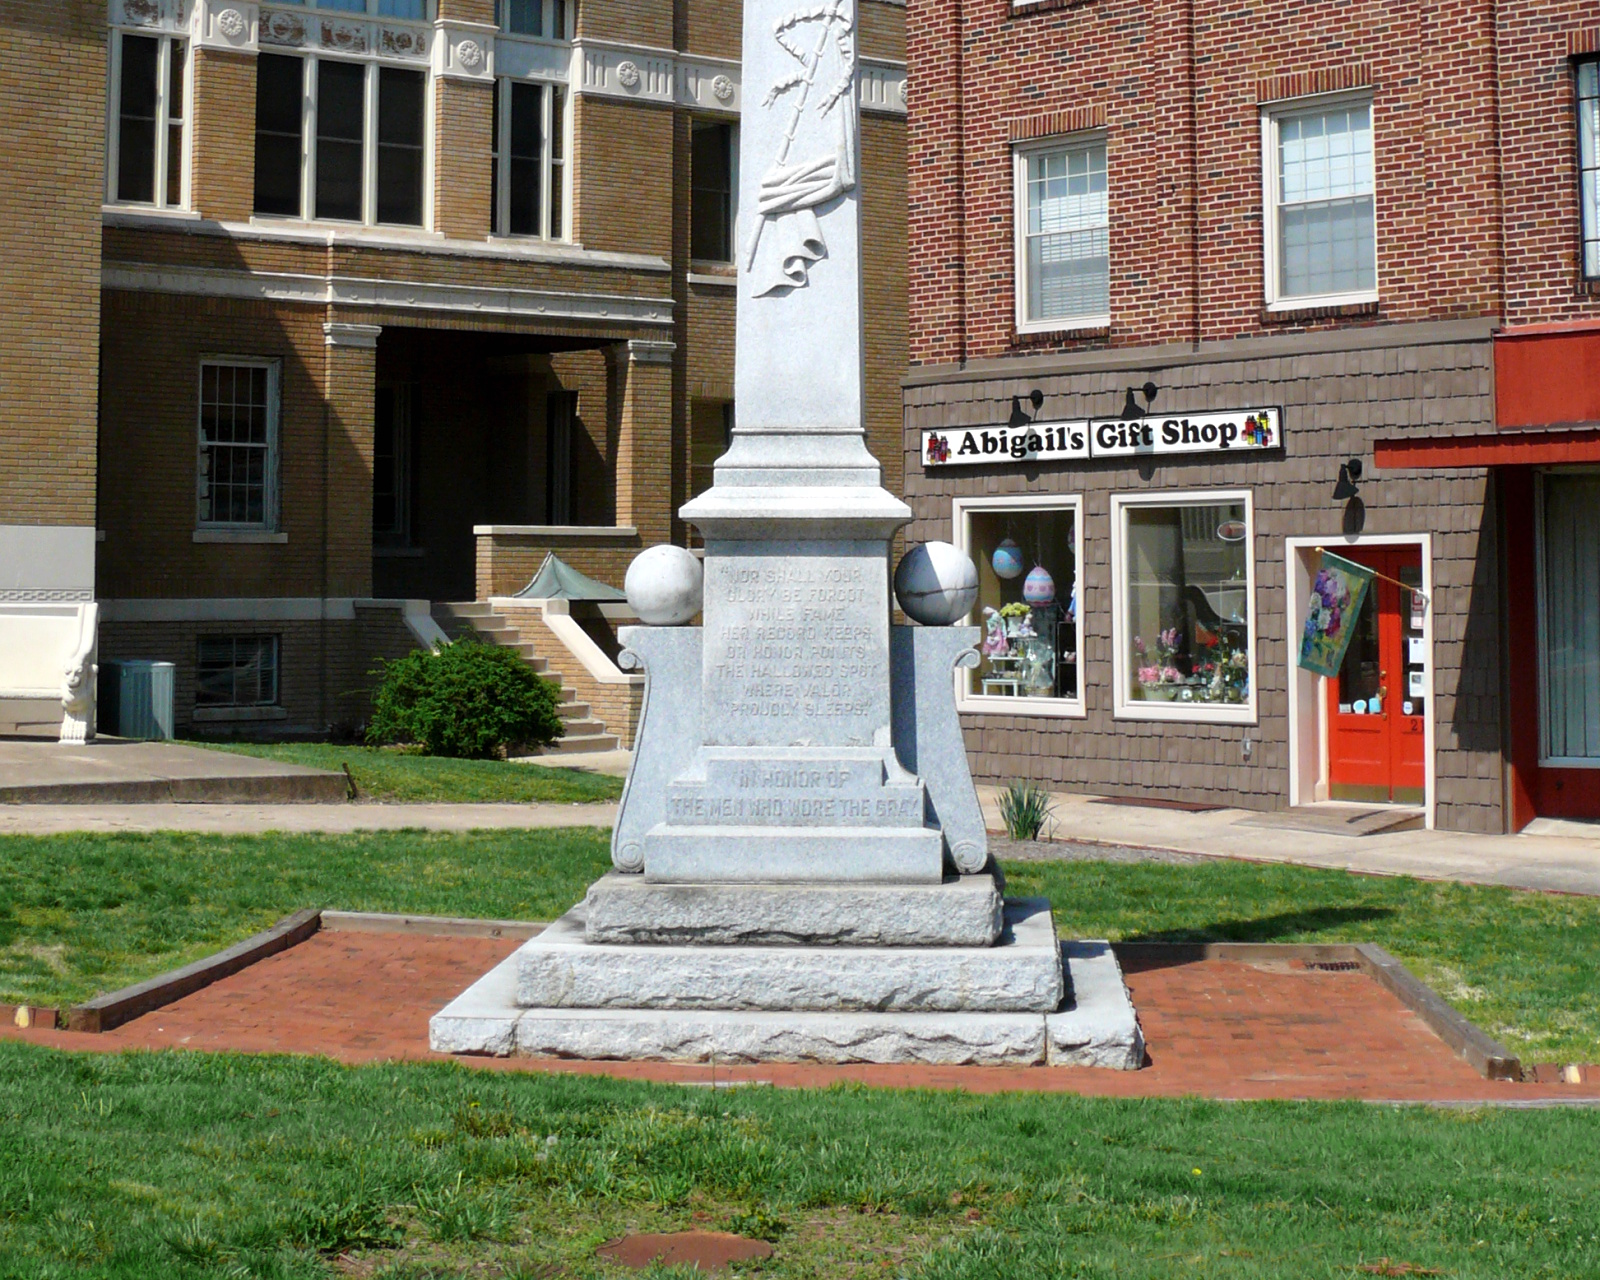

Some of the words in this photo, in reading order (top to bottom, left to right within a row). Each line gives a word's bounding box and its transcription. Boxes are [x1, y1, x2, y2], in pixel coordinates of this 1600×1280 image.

[956, 426, 1085, 459] Abigail's
[1096, 422, 1154, 449] Gift
[1161, 418, 1238, 449] Shop
[720, 568, 761, 584] "NOR
[764, 568, 816, 584] SHALL
[823, 568, 863, 584] YOUR
[726, 588, 777, 603] GLORY
[782, 588, 803, 603] BE
[807, 588, 865, 603] FORGOT
[749, 607, 795, 622] WHILE
[803, 607, 846, 622] FAME
[722, 625, 749, 641] HER
[757, 625, 817, 641] RECORD
[824, 625, 873, 641] KEEPS
[726, 646, 747, 660] OR
[752, 646, 803, 660] HONOR
[811, 646, 867, 660] POINTS
[715, 664, 745, 679] THE
[750, 664, 834, 679] HALLOWED
[840, 664, 878, 679] SPOT
[744, 683, 794, 698] WHERE
[804, 683, 852, 698] VALOR
[739, 770, 755, 788] IN
[763, 770, 821, 788] HONOR
[826, 770, 852, 788] OF
[670, 797, 706, 817] THE
[709, 797, 744, 817] MEN
[750, 797, 784, 817] WHO
[789, 797, 836, 817] WORE
[840, 797, 871, 817] THE
[875, 797, 920, 817] GRAY.
